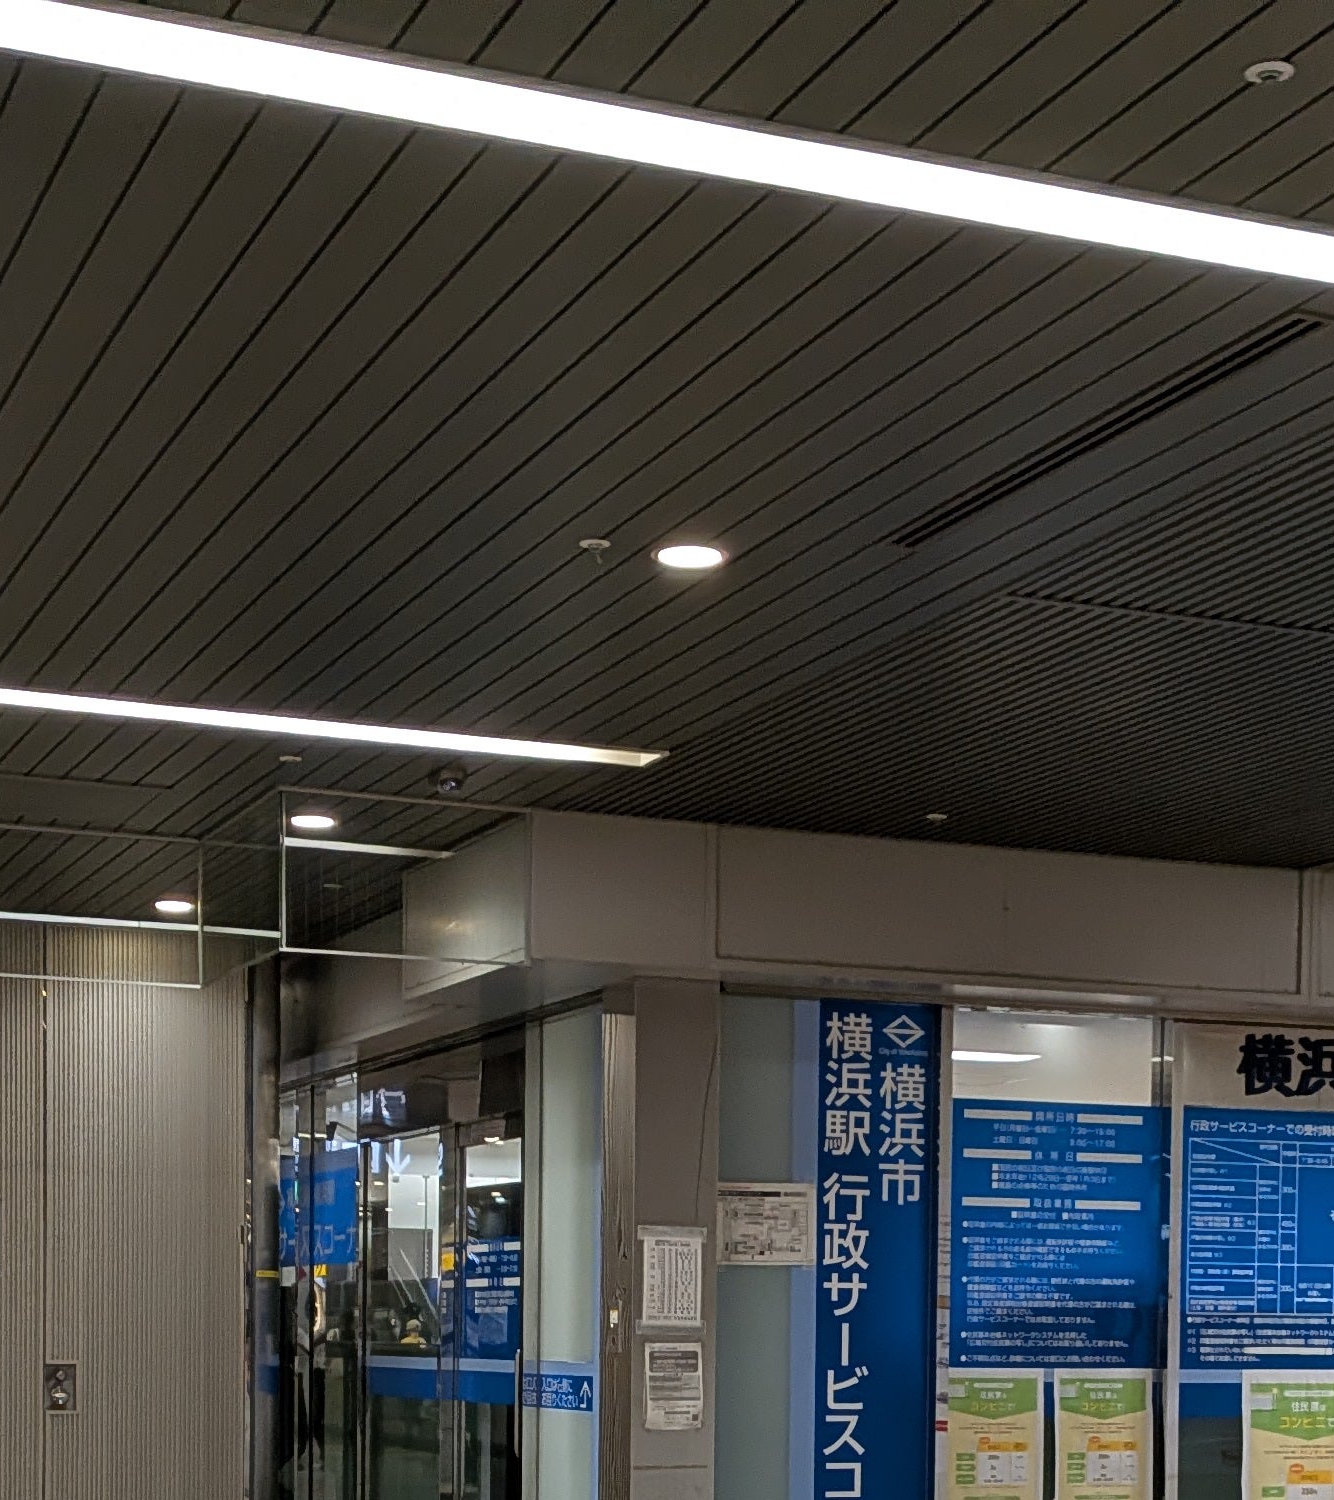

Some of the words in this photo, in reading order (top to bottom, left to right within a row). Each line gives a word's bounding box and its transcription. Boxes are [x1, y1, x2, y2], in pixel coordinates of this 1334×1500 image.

[824, 1011, 874, 1157] 横浜駅
[878, 1062, 927, 1206] 横浜市
